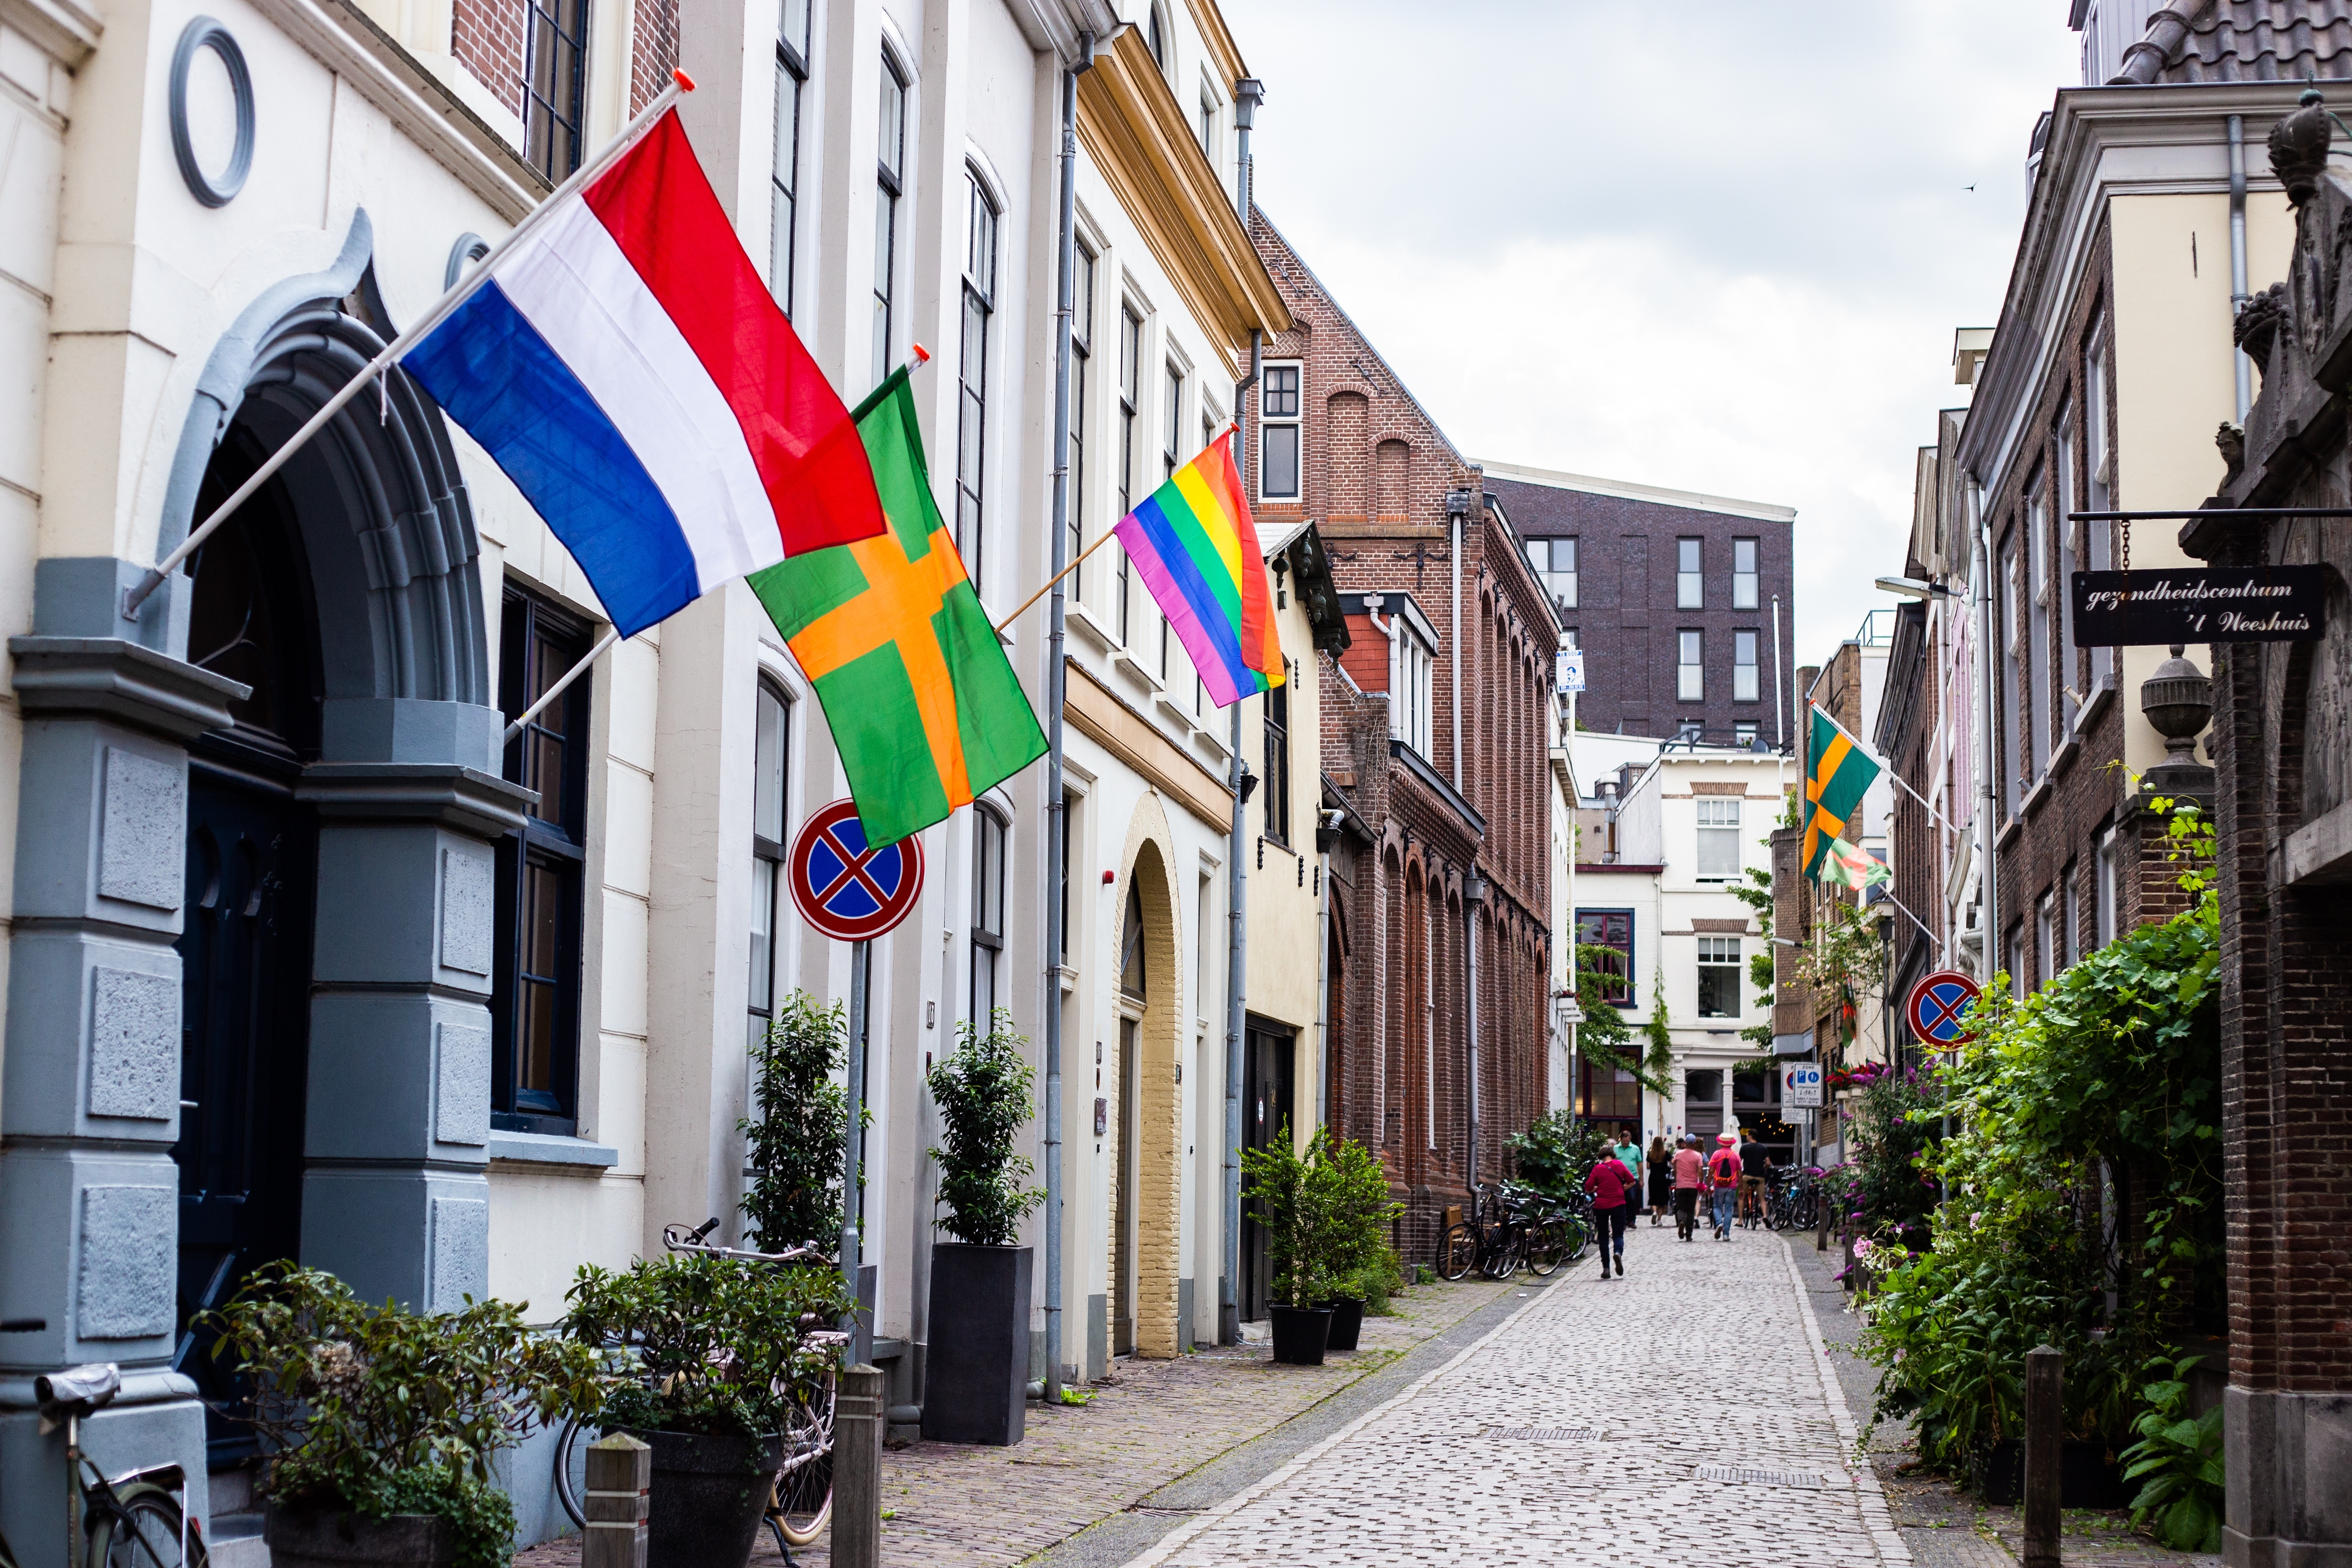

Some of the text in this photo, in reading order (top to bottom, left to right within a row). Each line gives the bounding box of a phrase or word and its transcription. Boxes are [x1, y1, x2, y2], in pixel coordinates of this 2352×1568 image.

[2085, 579, 2292, 611] gezondheidscentrum
[2218, 611, 2310, 632] Weeshuis
[929, 1005, 934, 1023] 18
